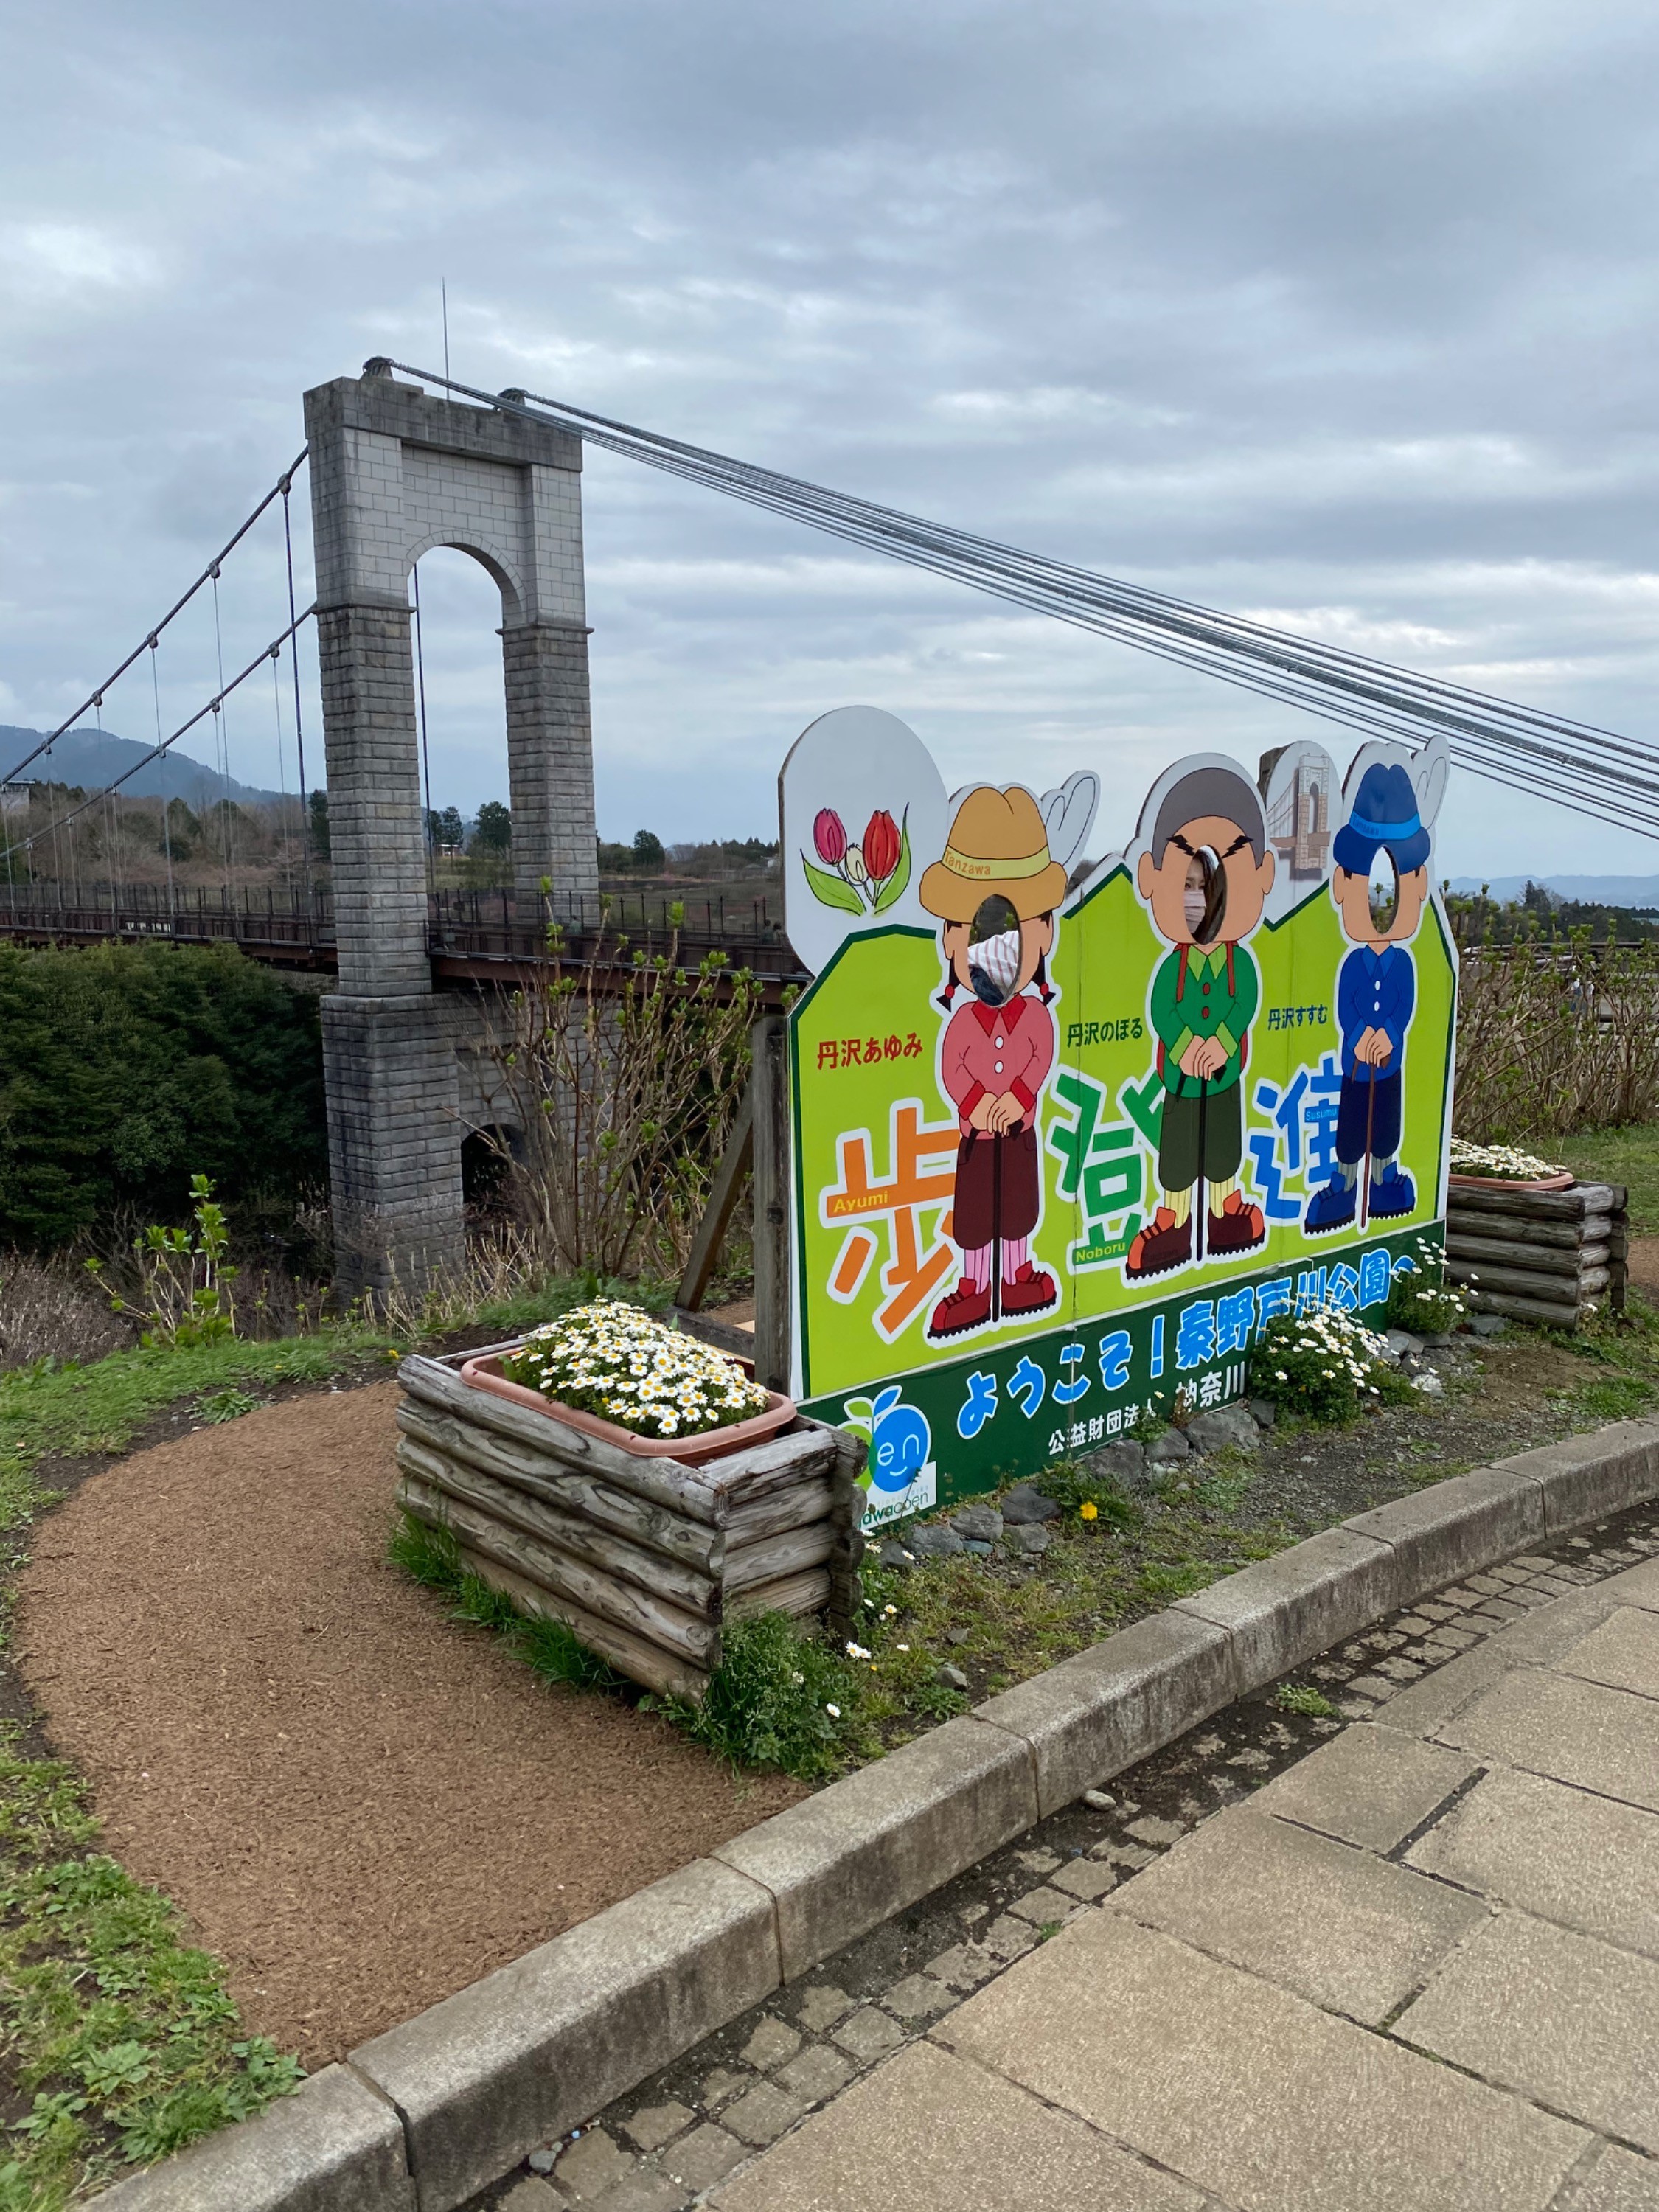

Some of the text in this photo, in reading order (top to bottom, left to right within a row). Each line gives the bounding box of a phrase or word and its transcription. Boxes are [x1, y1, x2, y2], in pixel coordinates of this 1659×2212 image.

[945, 849, 990, 875] Tanzawa
[1267, 1004, 1328, 1031] 丹沢すすむ
[1067, 1018, 1143, 1048] 丹沢のぼる
[817, 1032, 923, 1070] 丹沢あゆみ
[1050, 1069, 1166, 1266] 登
[833, 1190, 889, 1214] Ayumi
[1075, 1240, 1127, 1263] Noboru
